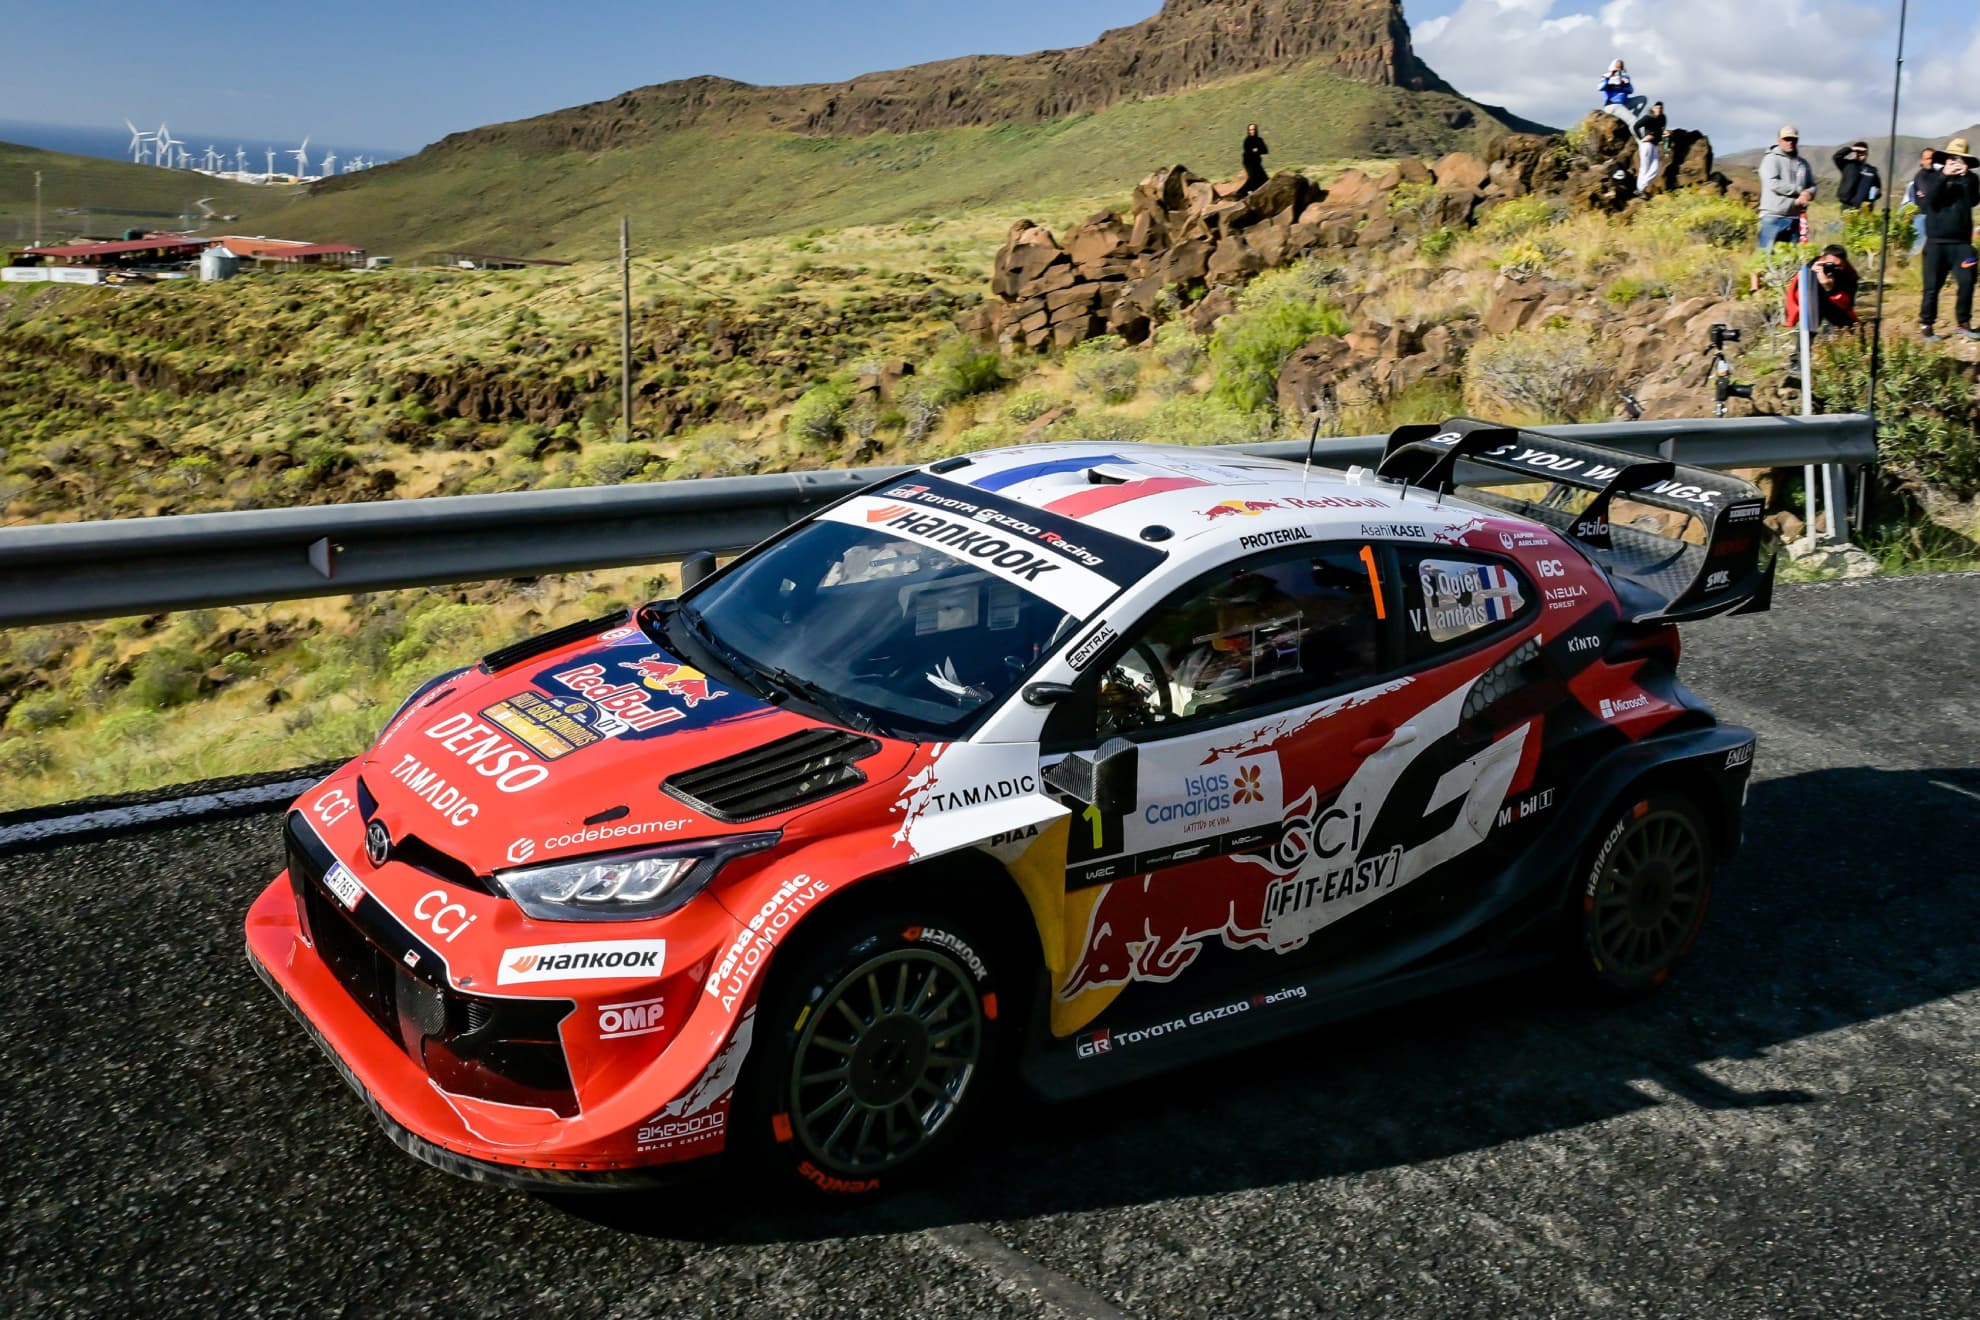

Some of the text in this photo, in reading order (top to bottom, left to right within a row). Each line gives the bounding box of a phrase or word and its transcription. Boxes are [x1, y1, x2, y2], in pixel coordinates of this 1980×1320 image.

[1511, 448, 1584, 472] YOU
[1582, 465, 1722, 507] WNGS.
[917, 492, 975, 513] TOYOTA
[1038, 532, 1104, 565] Racing
[1240, 526, 1312, 549] PROTERIAL
[1577, 521, 1609, 537] Stilo
[1360, 545, 1385, 619] 1
[1549, 601, 1575, 609] FOREST
[1068, 628, 1113, 668] CENTRAL
[1612, 694, 1648, 712] Microsoft
[425, 712, 549, 793] DENSO
[390, 753, 479, 828] TAMADIC
[932, 776, 1034, 811] TAMADIC
[1185, 774, 1229, 797] Islas
[1082, 804, 1103, 849] 1
[1145, 794, 1230, 824] Canarias
[1499, 796, 1537, 827] Mobil
[544, 818, 687, 850] codebeamer
[991, 824, 1038, 847] PIAA
[705, 873, 809, 998] Panasonic
[721, 879, 829, 1013] AUTOMOTIVE
[600, 1004, 664, 1033] OMP
[1079, 985, 1307, 1057] GR TOYOTA GAZOO Racing
